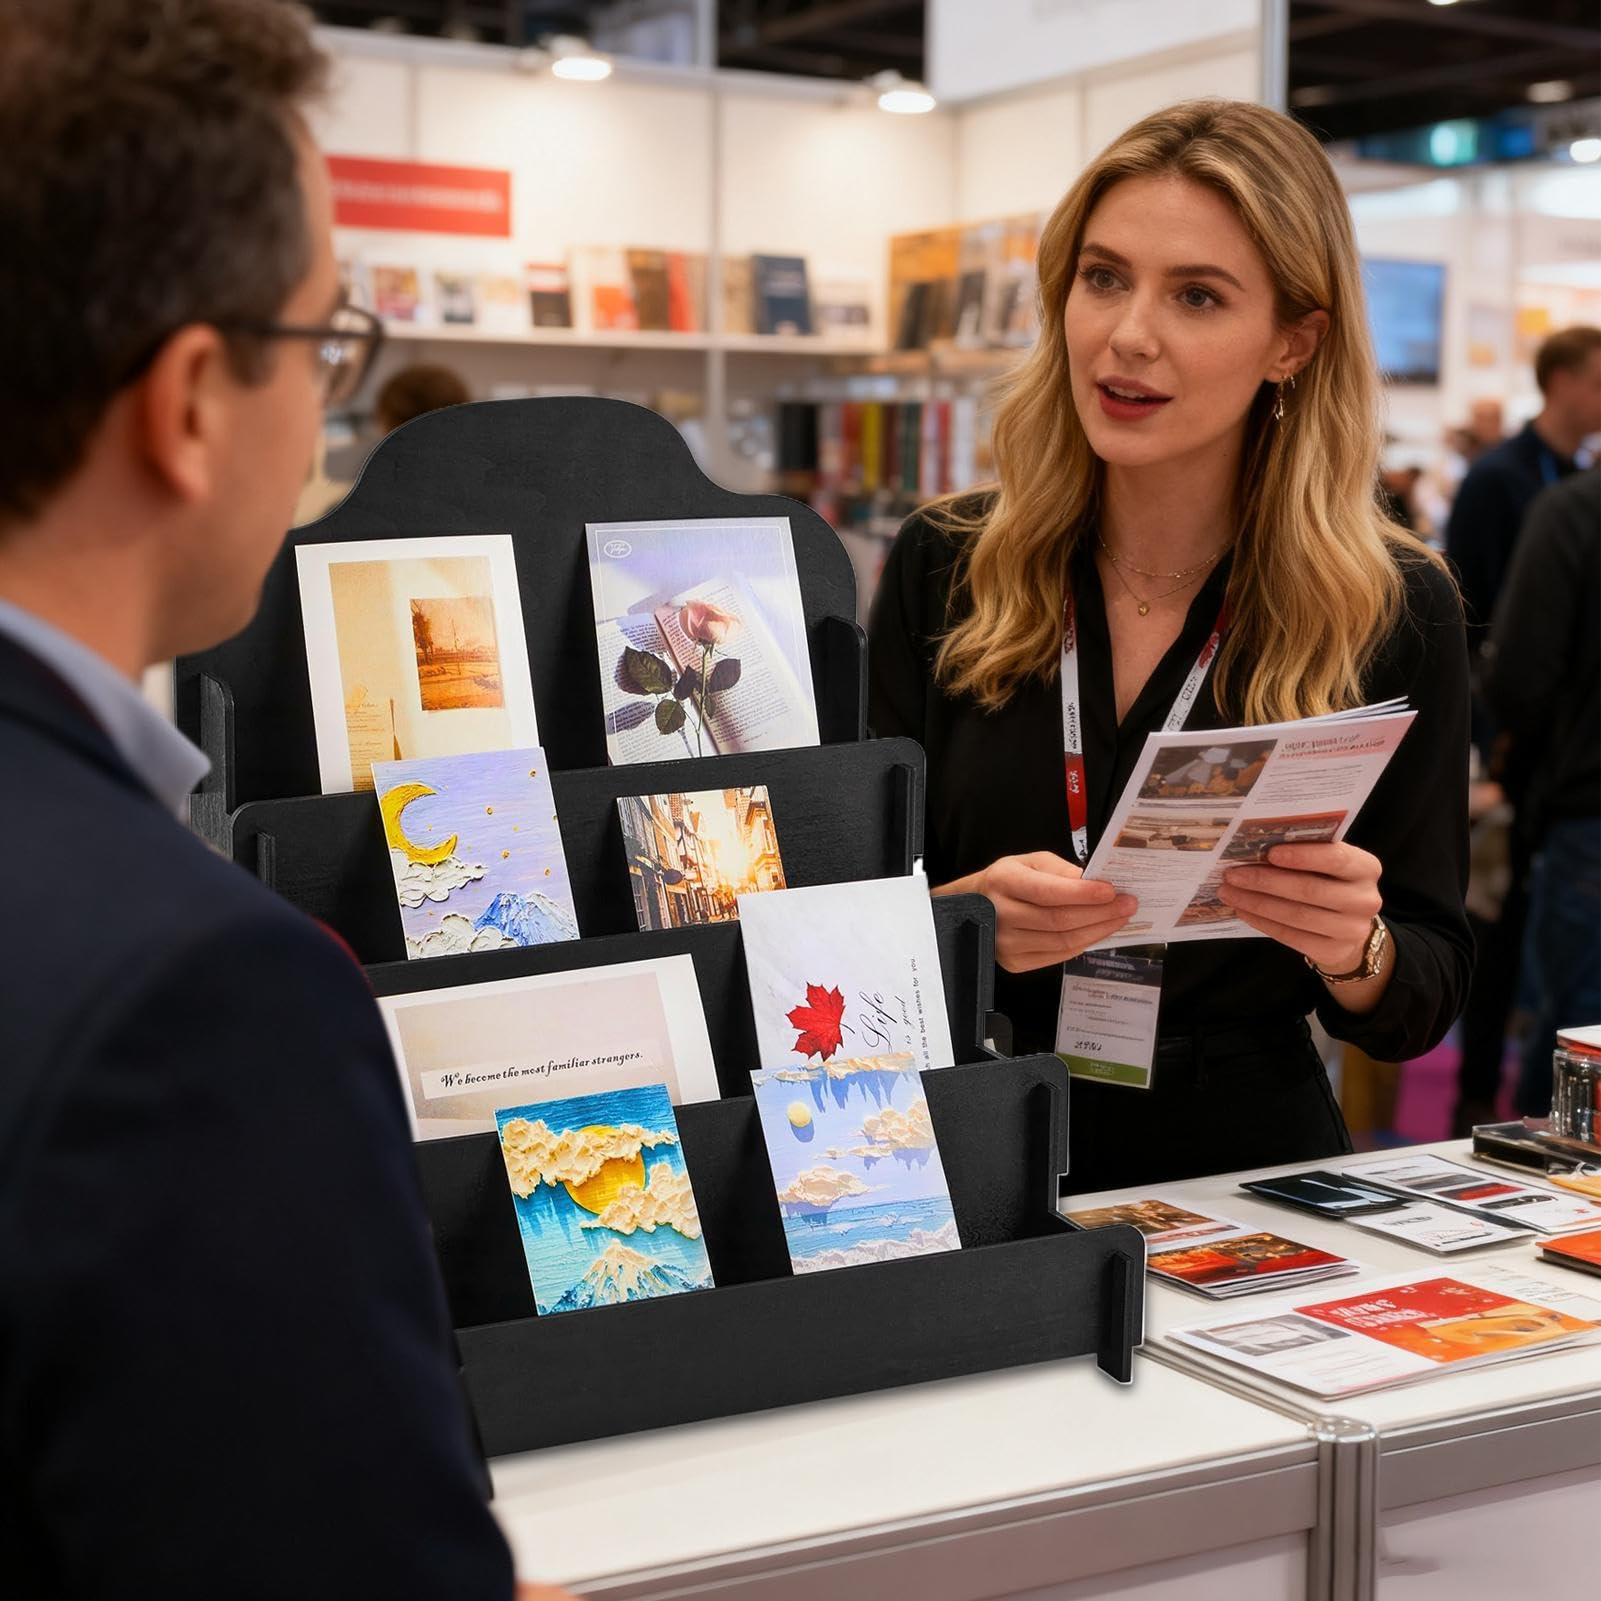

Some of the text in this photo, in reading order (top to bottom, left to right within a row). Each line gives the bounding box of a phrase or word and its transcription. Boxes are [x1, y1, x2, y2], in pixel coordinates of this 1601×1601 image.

[912, 976, 920, 987] for
[915, 989, 923, 1014] wishes
[859, 991, 897, 1053] Life
[918, 1017, 926, 1033] best
[440, 1052, 643, 1087] We become the most familiar strangers.
